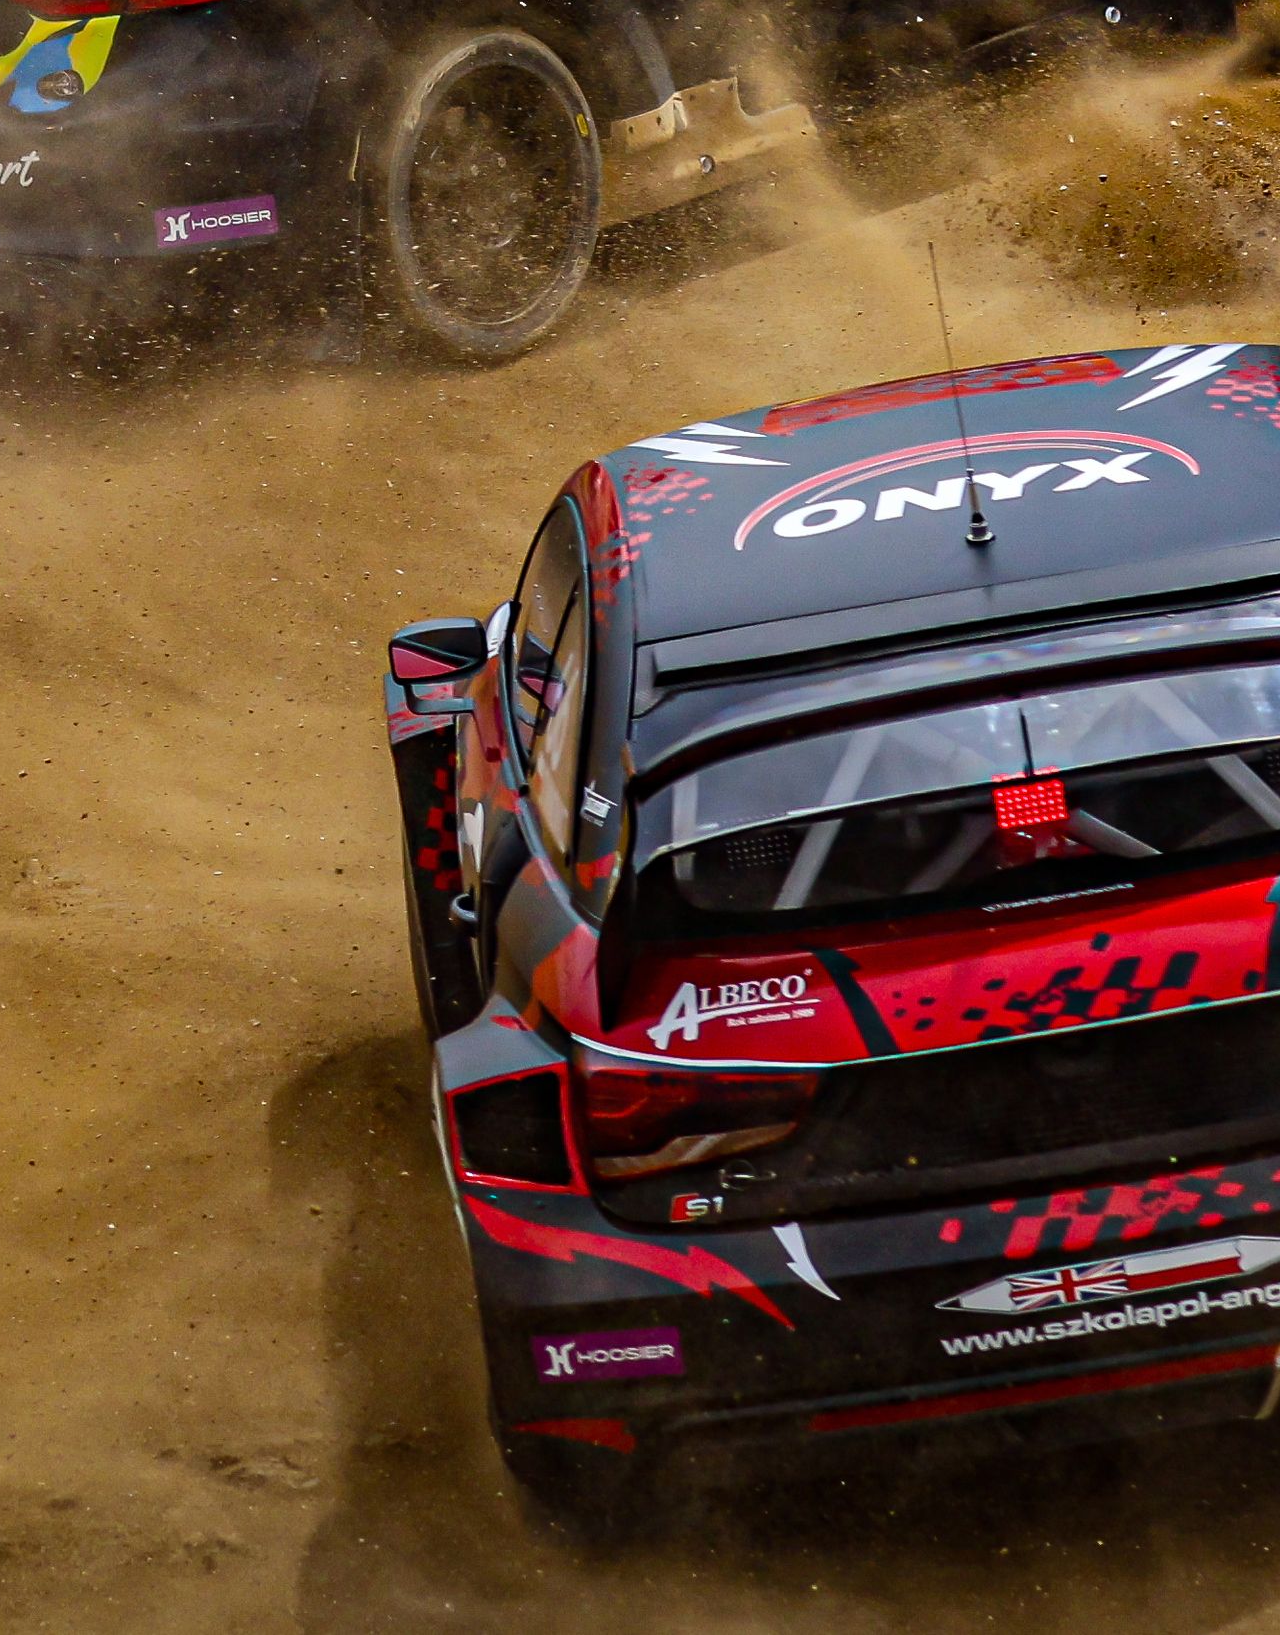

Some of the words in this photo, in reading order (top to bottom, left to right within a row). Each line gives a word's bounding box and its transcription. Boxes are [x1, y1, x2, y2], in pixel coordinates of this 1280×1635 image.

[191, 209, 272, 230] HOOSIER
[773, 451, 1153, 538] ONYX
[646, 974, 807, 1050] ALBECO
[685, 1195, 724, 1217] S1
[576, 1343, 675, 1364] HOOSIER
